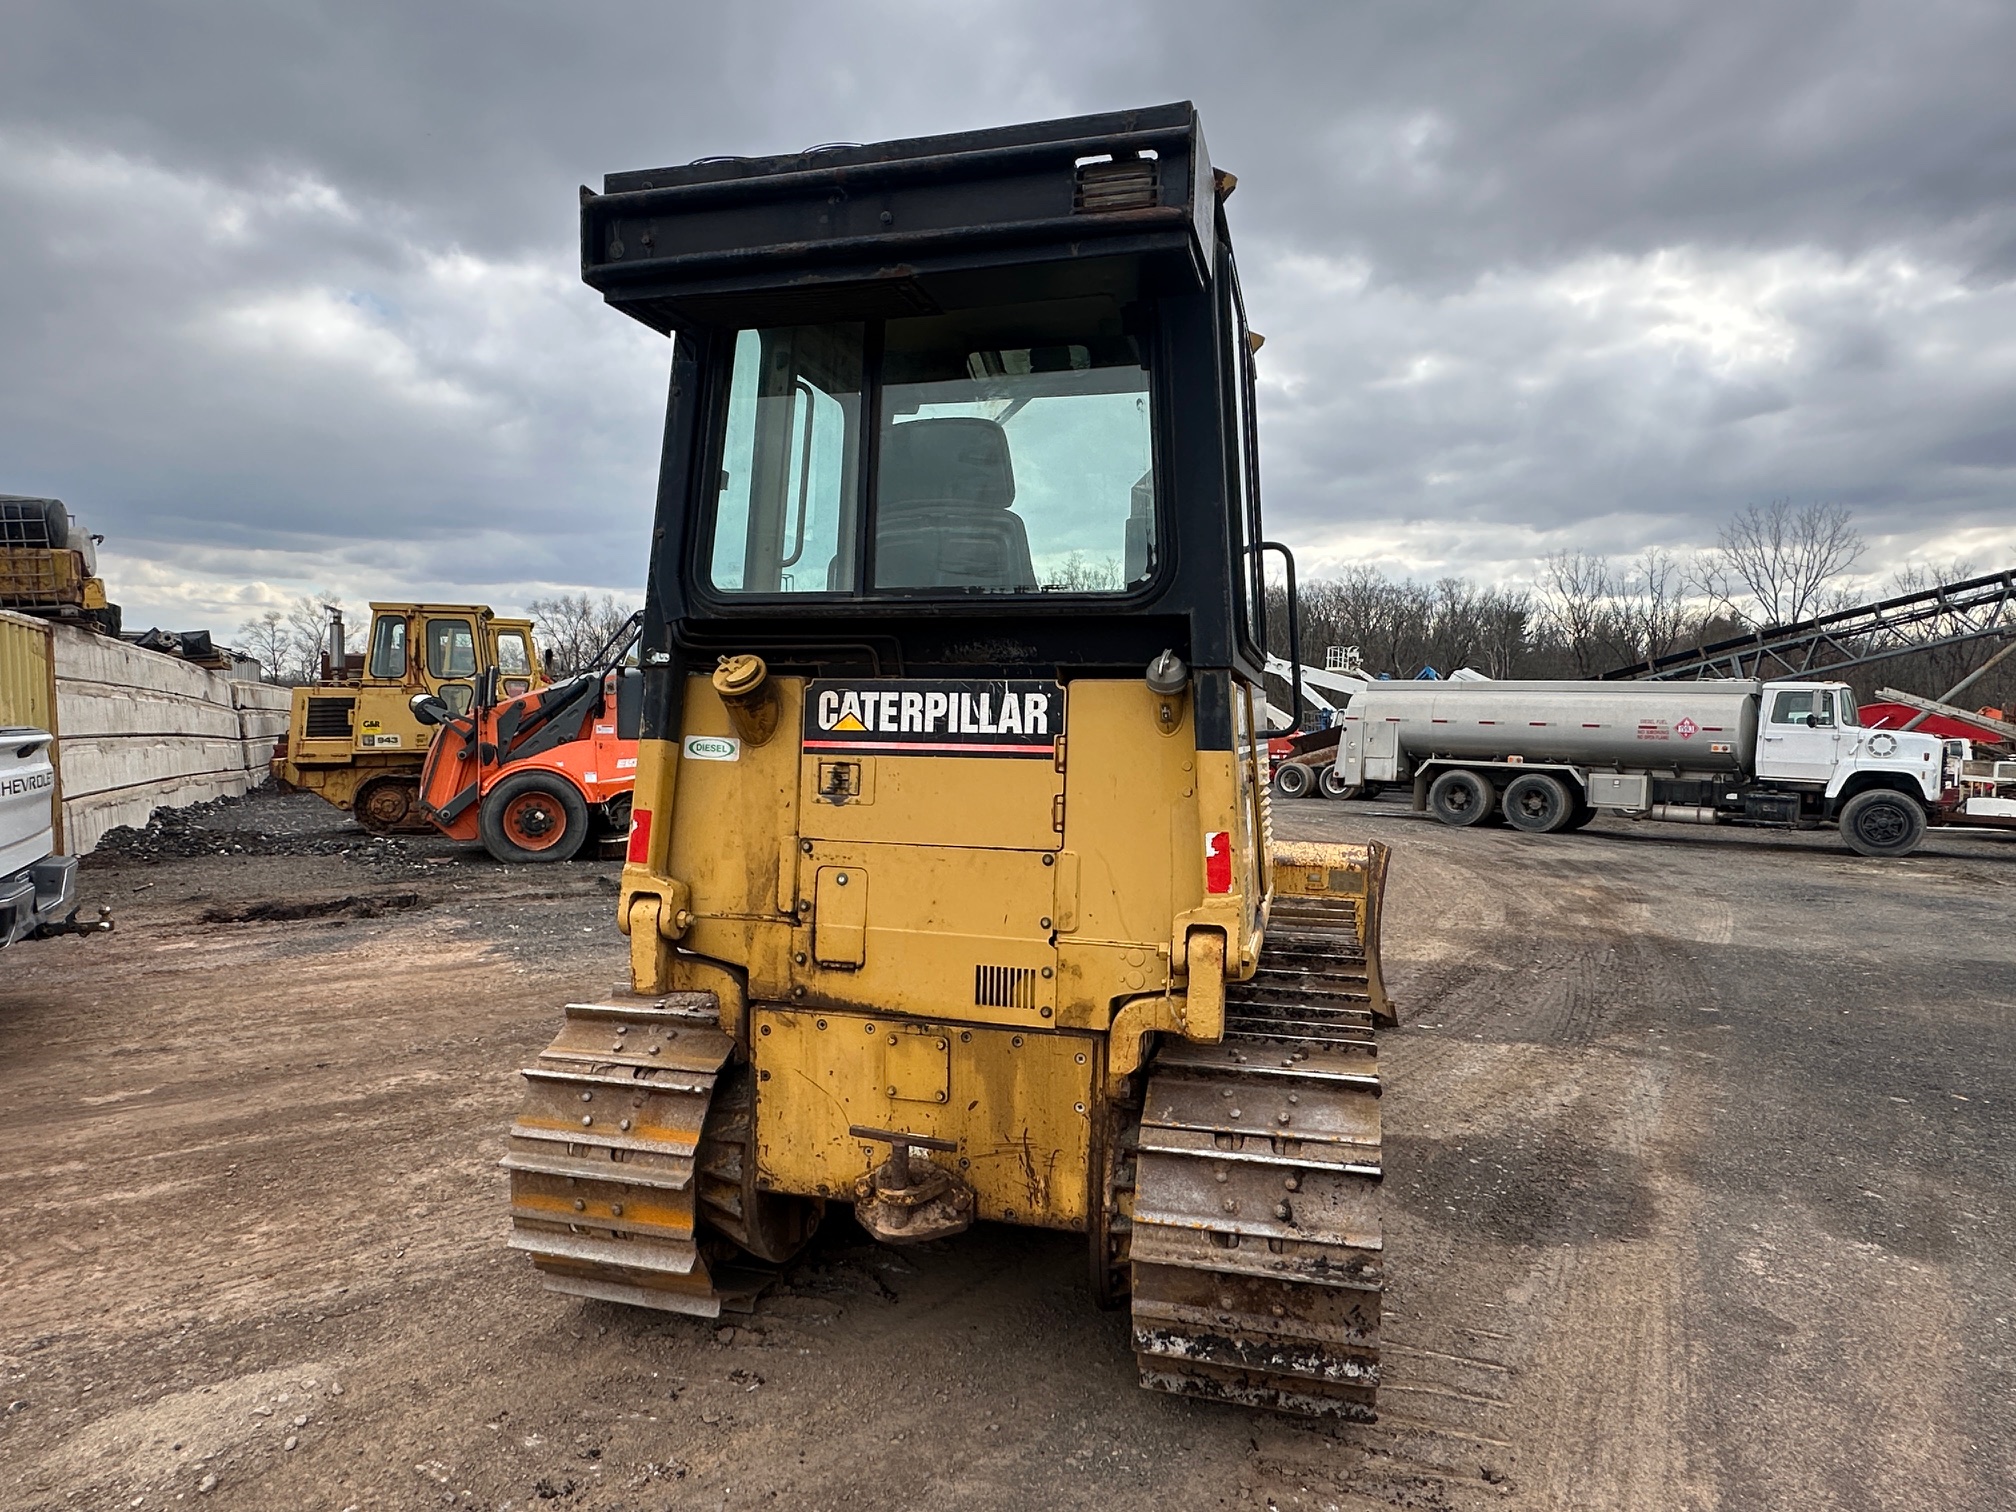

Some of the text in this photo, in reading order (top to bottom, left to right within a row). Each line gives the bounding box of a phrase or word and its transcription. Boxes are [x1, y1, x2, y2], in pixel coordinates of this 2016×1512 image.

[818, 690, 1048, 734] CATERPILLAR
[696, 743, 727, 752] DIESEL
[0, 771, 53, 797] HEVROLE
